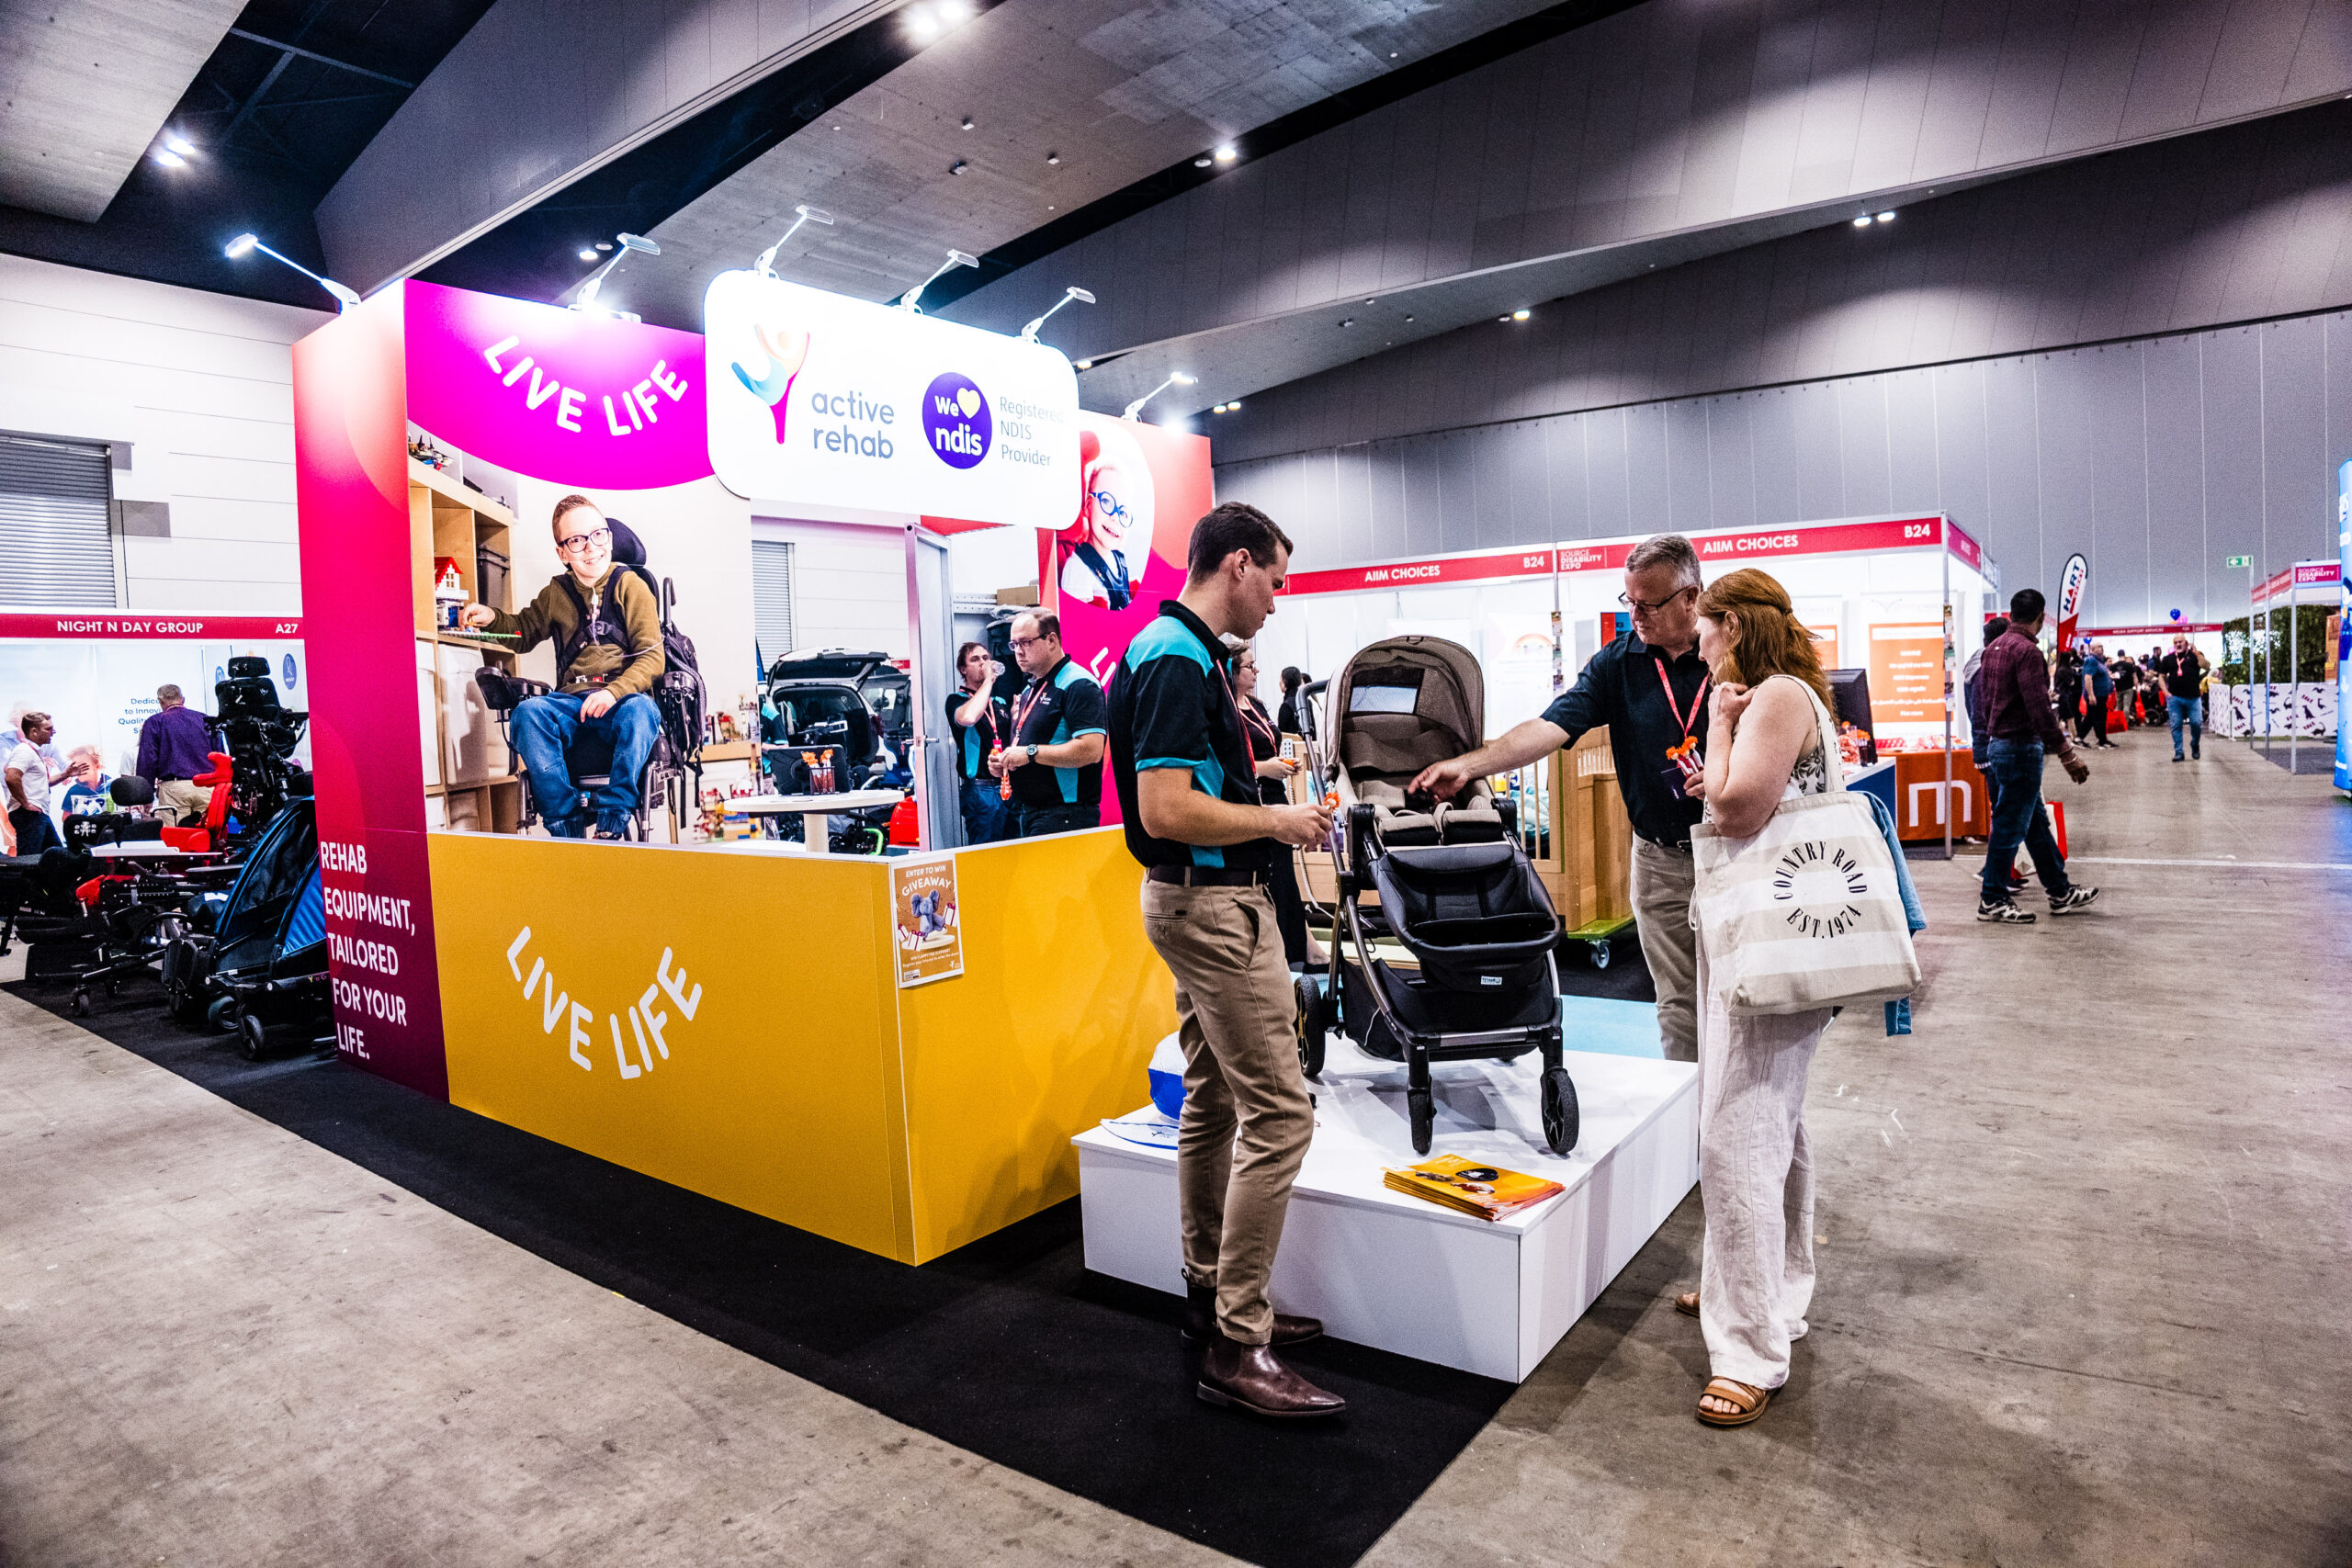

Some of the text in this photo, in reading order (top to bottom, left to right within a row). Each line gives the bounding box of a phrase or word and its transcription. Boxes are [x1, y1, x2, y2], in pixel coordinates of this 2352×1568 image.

[483, 334, 689, 437] LIVE LIFE
[811, 389, 896, 425] active
[934, 395, 959, 418] We
[1000, 396, 1065, 424] Registered
[934, 423, 984, 457] ndis
[1000, 420, 1032, 441] NDIS
[813, 425, 895, 460] rehab
[1001, 444, 1052, 467] Provider
[1904, 524, 1931, 539] B24
[1560, 549, 1590, 558] SOURCE
[1703, 535, 1799, 554] AIIM CHOICES
[1523, 556, 1545, 569] B24
[1560, 554, 1602, 565] DISABILITY
[1560, 562, 1582, 570] EXPO
[1364, 565, 1441, 581] AIIM CHOICES
[57, 620, 204, 634] NIGHT N DAY GROUP
[275, 623, 299, 634] A27
[320, 840, 368, 874] REHAB
[905, 863, 946, 878] ENTER TO WIN
[1773, 840, 1868, 900] COUNTRY ROAD
[901, 876, 952, 897] GIVEAWAY
[323, 886, 416, 937] EQUIPMENT,
[327, 932, 399, 976] TAILORED
[333, 977, 407, 1027] FOR YOUR
[506, 925, 703, 1080] LIVE LIFE
[336, 1021, 370, 1060] LIFE.
